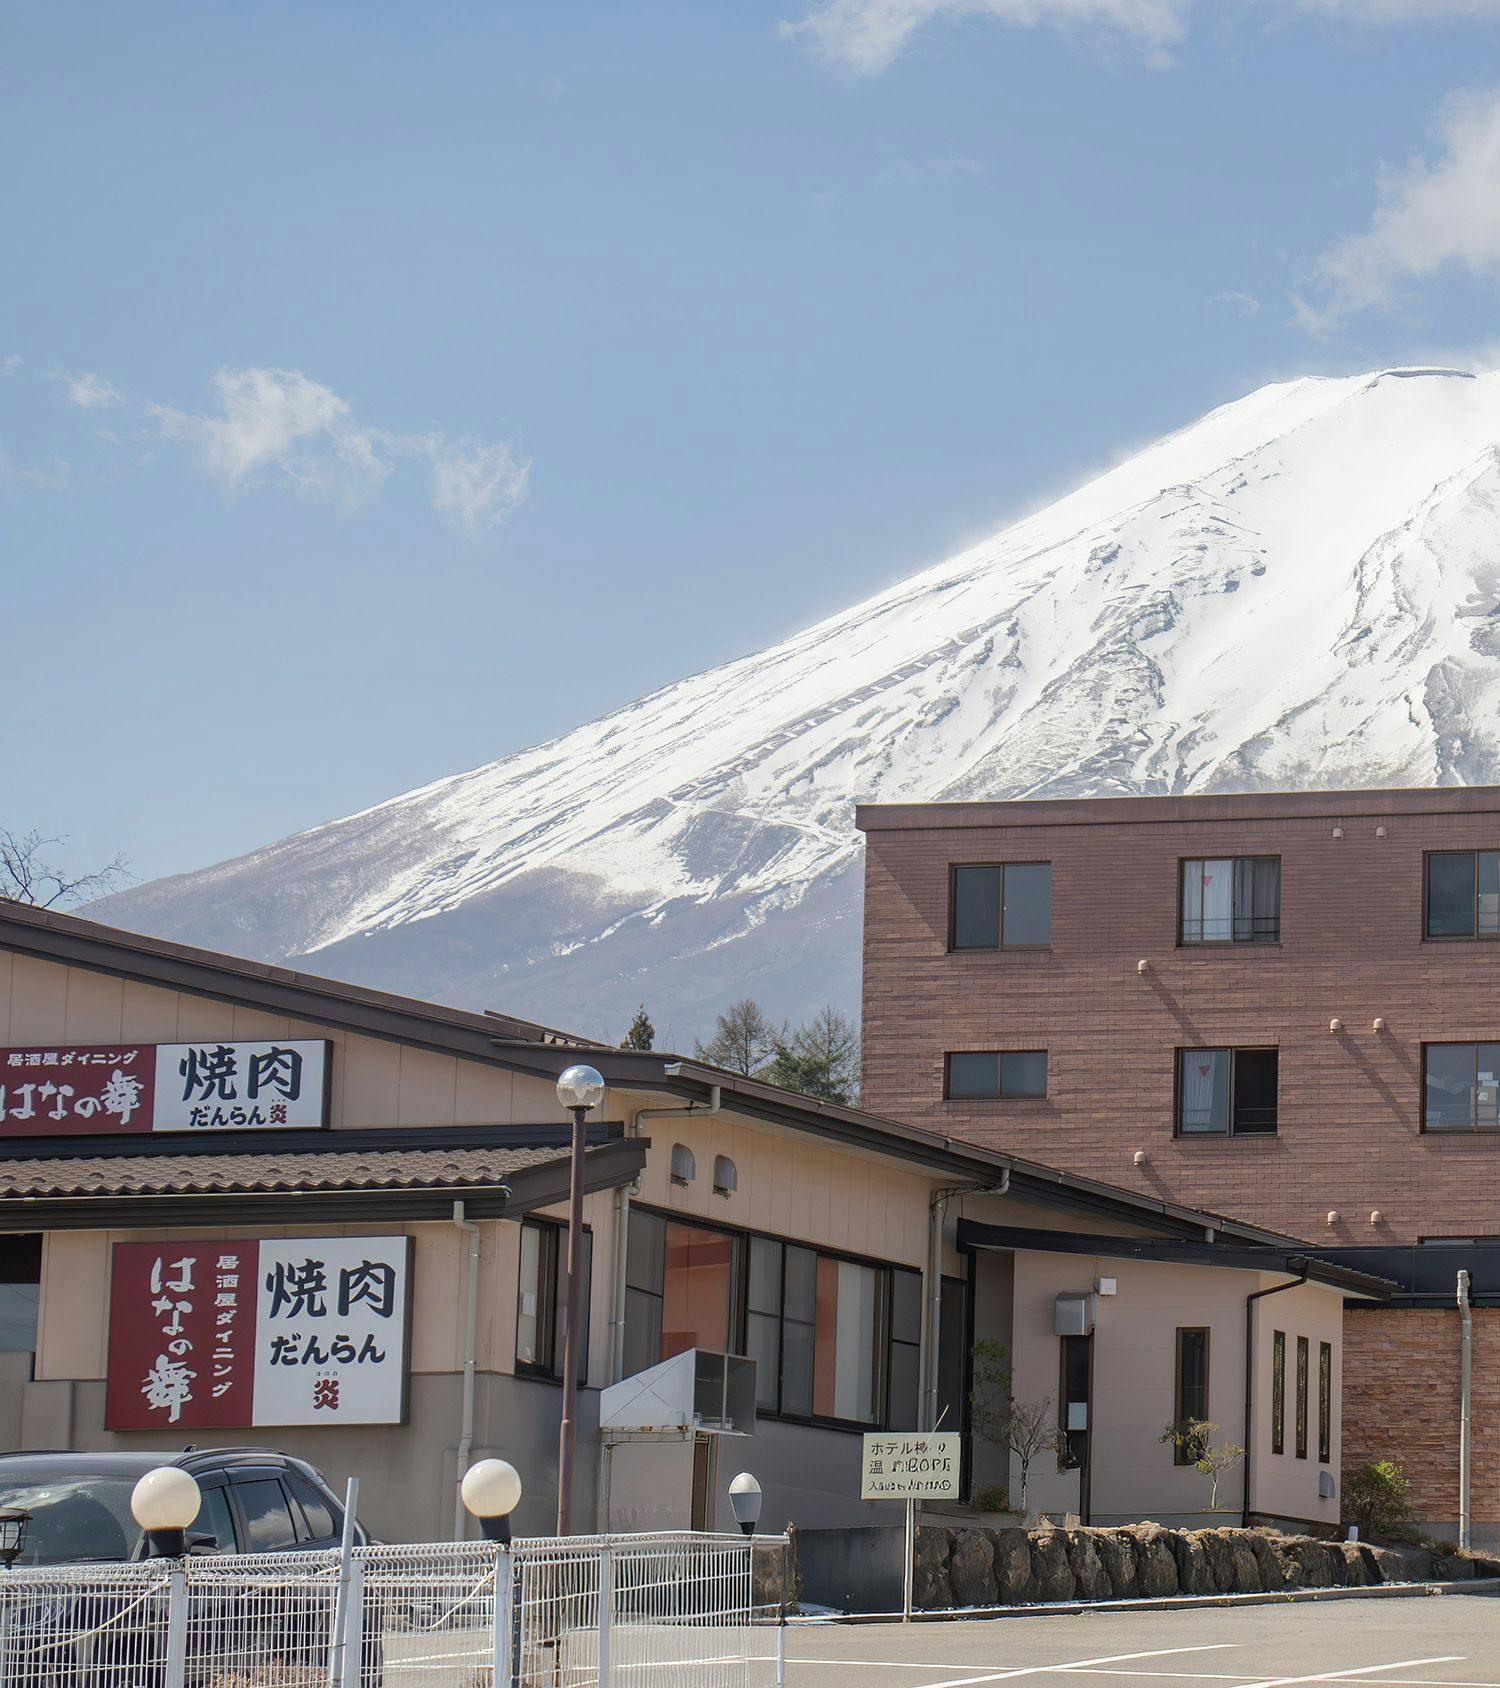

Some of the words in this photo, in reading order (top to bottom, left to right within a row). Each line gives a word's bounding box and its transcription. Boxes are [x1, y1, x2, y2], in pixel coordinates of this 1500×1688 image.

[7, 1050, 138, 1066] 居酒屋ダイニング
[179, 1044, 303, 1101] 焼肉
[266, 1258, 396, 1319] 焼肉
[141, 1257, 198, 1423] はなの舞
[212, 1255, 240, 1397] 居酒屋ダイニング
[270, 1332, 386, 1366] だんらん
[313, 1379, 339, 1410] 炎
